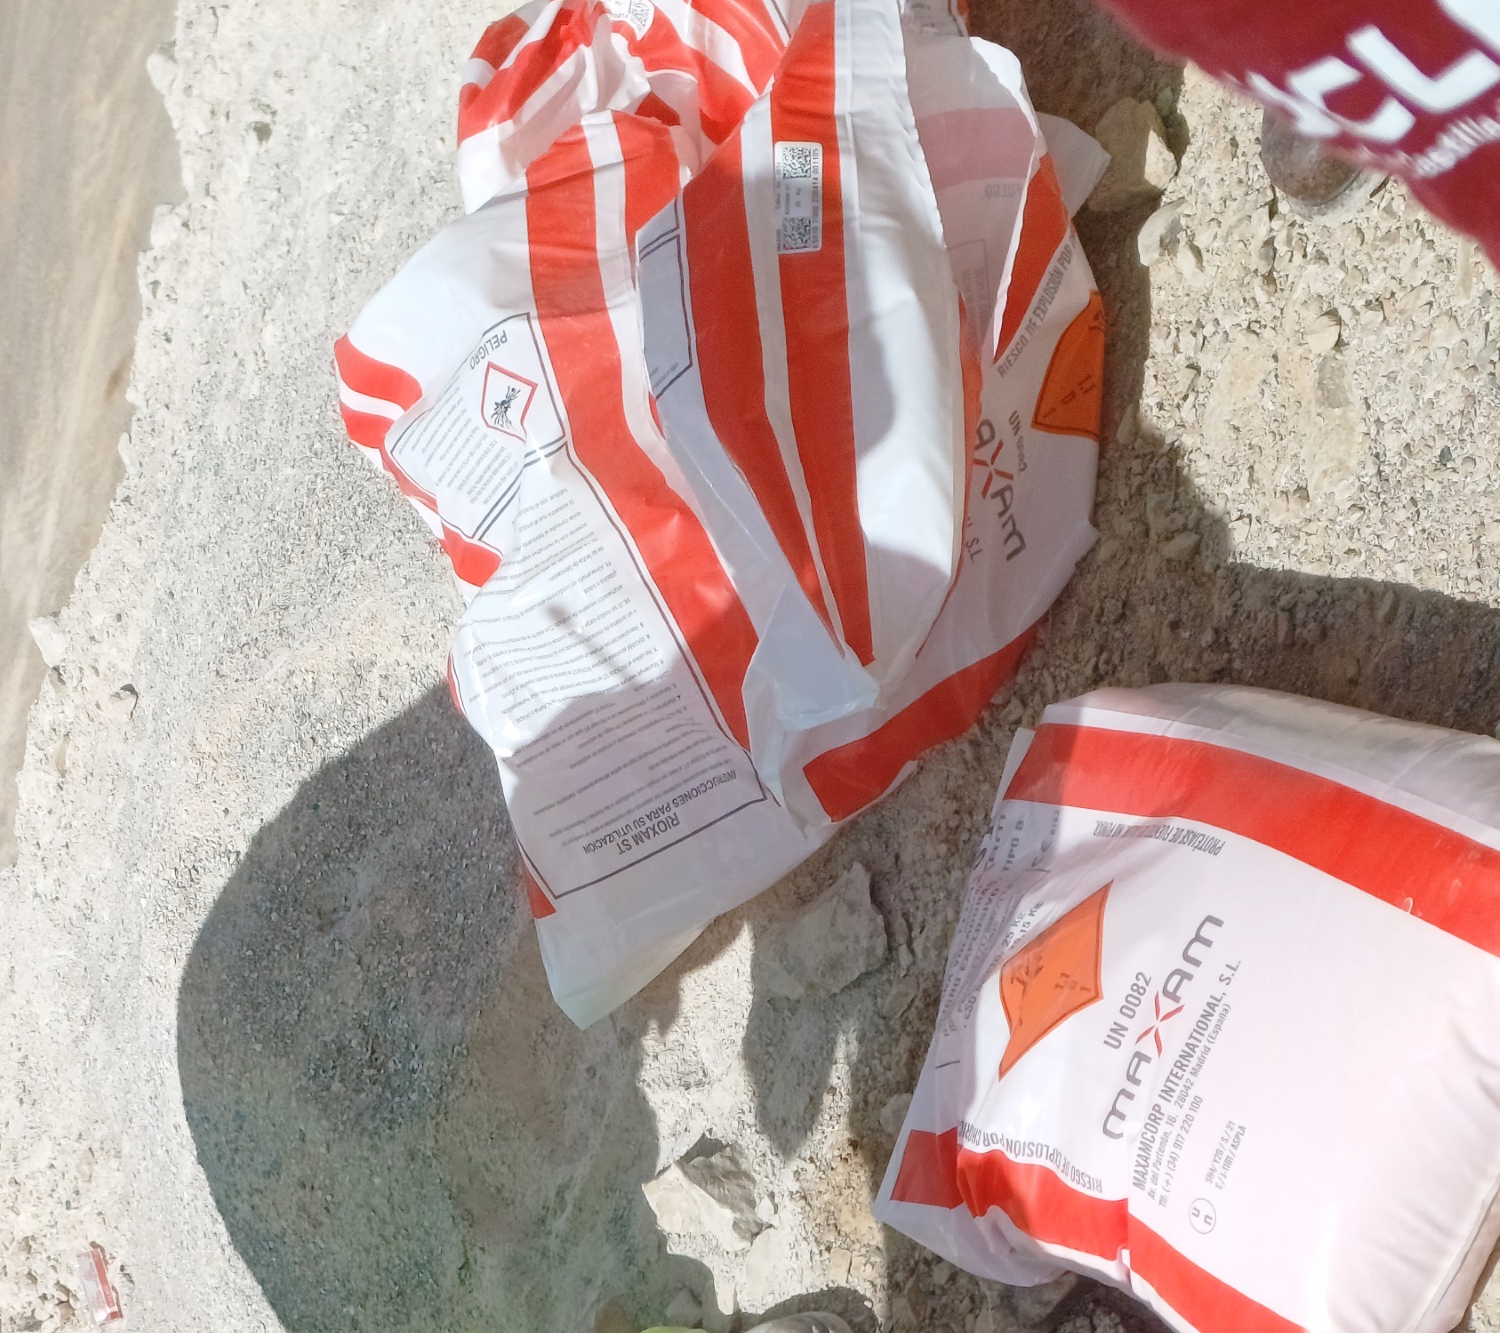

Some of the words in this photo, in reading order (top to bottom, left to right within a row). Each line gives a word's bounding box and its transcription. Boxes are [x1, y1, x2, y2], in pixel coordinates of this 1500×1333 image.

[996, 334, 1029, 377] RIESGO
[1024, 317, 1038, 334] DE
[1032, 264, 1065, 321] EXPLOSIÓN
[1056, 243, 1075, 270] POR
[468, 329, 508, 369] PELIGRO
[1008, 410, 1021, 435] UN
[965, 536, 982, 563] S.L.
[670, 768, 736, 808] INSTRUCCIONES
[632, 815, 646, 828] SU
[644, 801, 671, 821] PARA
[582, 823, 632, 853] UTILIZACIÓN
[630, 812, 680, 846] RIOXAM
[1178, 828, 1225, 855] PROTÉJASE
[615, 837, 632, 855] ST
[1103, 1020, 1129, 1050] UN
[1118, 970, 1153, 1020] 0082
[1206, 1003, 1232, 1044] (España)
[1100, 912, 1224, 1139] MAXAM
[1189, 1045, 1211, 1077] Madrid
[1132, 1102, 1167, 1191] MAXAMCORP
[1158, 988, 1226, 1103] INTERNATIONAL,
[1217, 961, 1241, 986] S.L.
[1173, 1078, 1194, 1108] 28042
[1188, 1094, 1203, 1113] 100
[1179, 1112, 1195, 1134] 220
[983, 1131, 1003, 1146] POR
[1152, 1128, 1172, 1170] Partenón,
[1172, 1133, 1186, 1151] 917
[1231, 1125, 1247, 1150] ASPLA
[1006, 1138, 1060, 1169] EXPLOSIÓN
[1166, 1150, 1181, 1172] (34)
[1071, 1165, 1101, 1193] RIESGO
[1149, 1171, 1159, 1185] del
[1160, 1172, 1173, 1193] (+)
[1147, 1188, 1157, 1200] Av.
